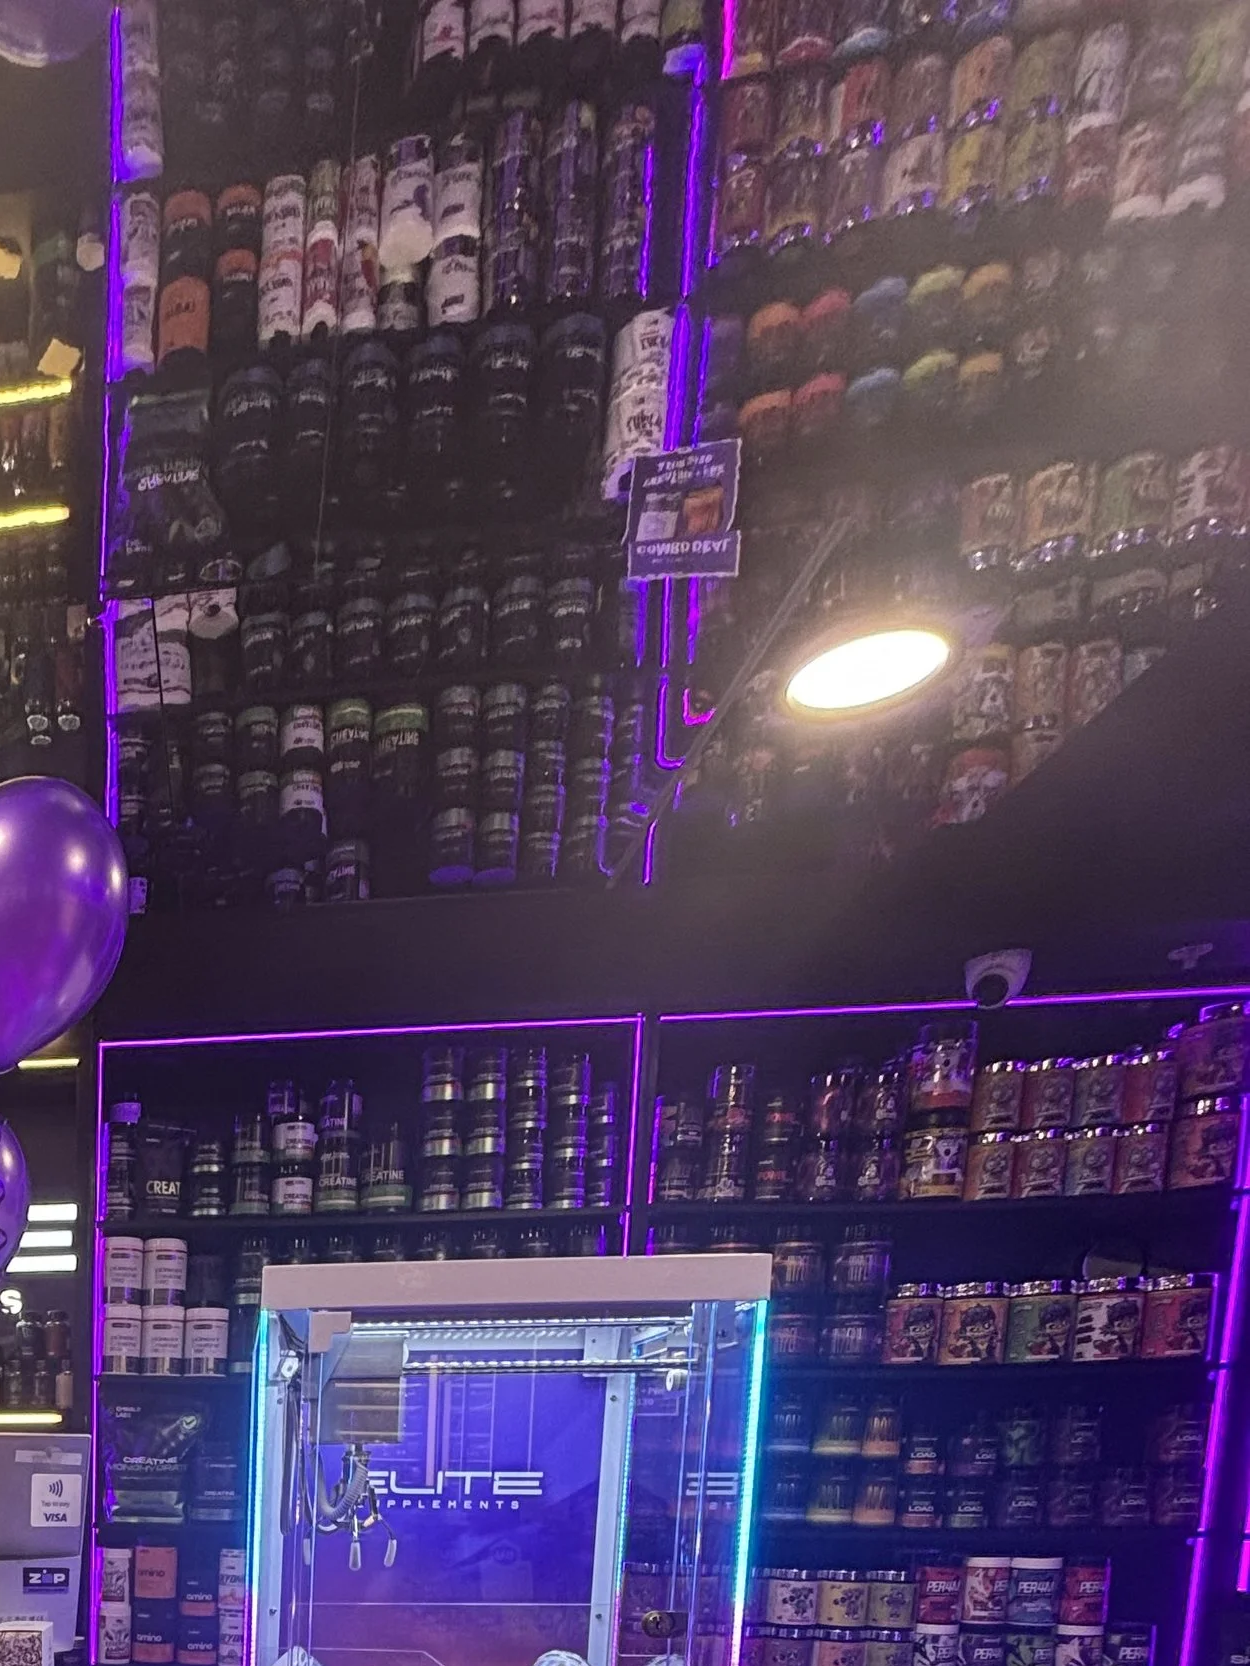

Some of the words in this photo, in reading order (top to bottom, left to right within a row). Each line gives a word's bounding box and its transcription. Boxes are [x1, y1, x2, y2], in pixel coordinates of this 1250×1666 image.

[43, 1513, 68, 1522] VISA
[186, 1593, 213, 1601] amino
[187, 1642, 213, 1651] amino
